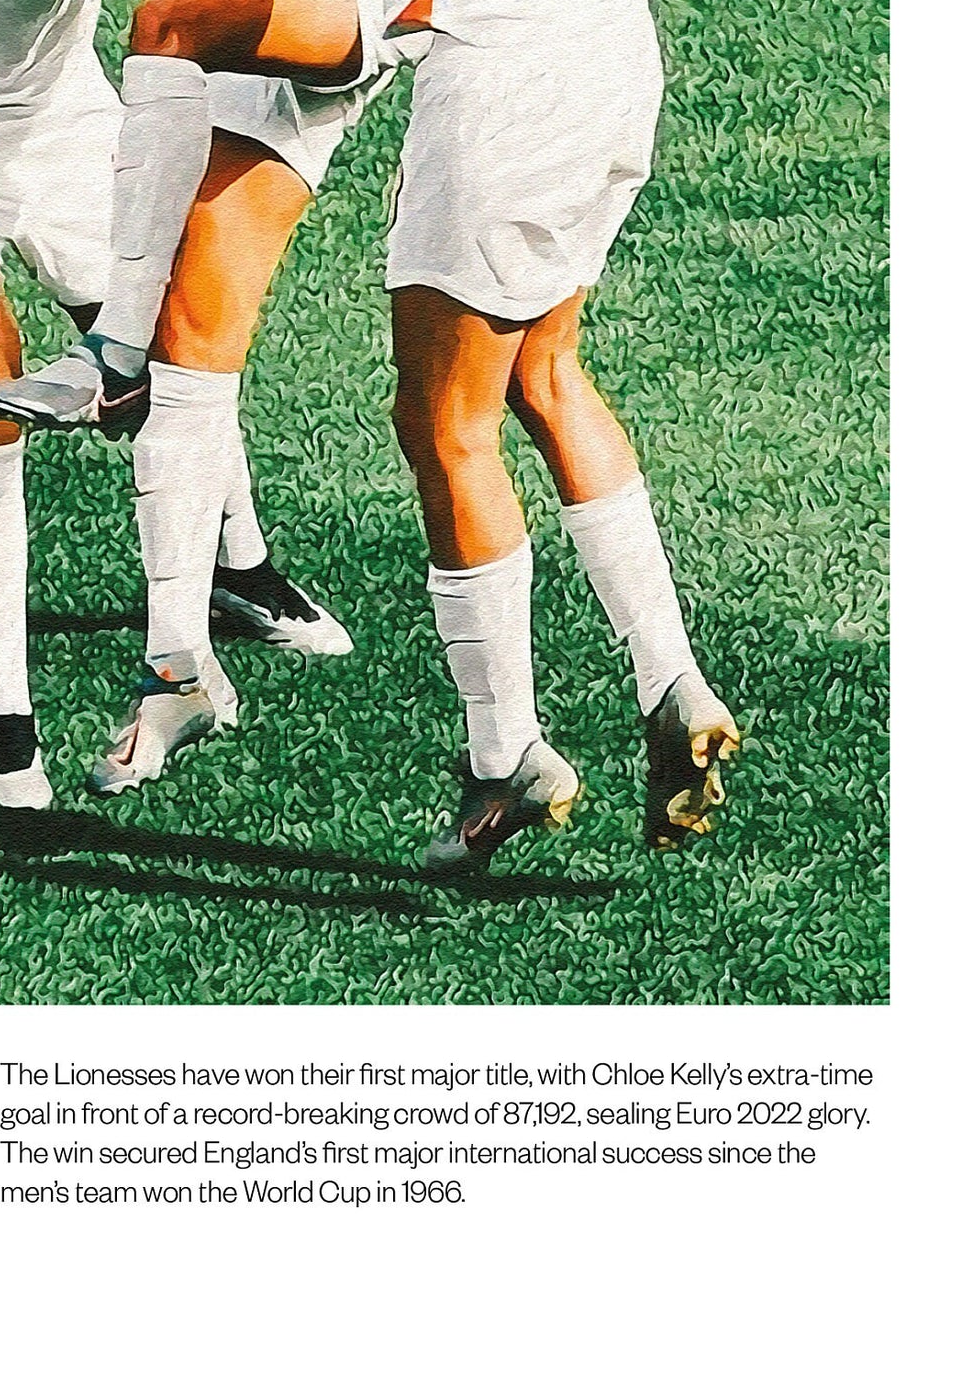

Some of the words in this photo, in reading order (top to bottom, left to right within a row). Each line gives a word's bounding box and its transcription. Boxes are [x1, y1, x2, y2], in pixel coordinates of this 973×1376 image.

[0, 1063, 48, 1085] The
[55, 1063, 176, 1085] Lionesses
[183, 1063, 239, 1085] have
[245, 1069, 293, 1085] won
[301, 1063, 355, 1085] their
[359, 1063, 405, 1085] first
[412, 1063, 480, 1091] major
[486, 1063, 532, 1087] title,
[538, 1063, 585, 1085] with
[592, 1063, 664, 1085] Chloe
[671, 1063, 742, 1090] Kelly’s
[748, 1063, 873, 1085] extra-time
[0, 1102, 50, 1130] goal
[57, 1102, 75, 1124] in
[81, 1102, 138, 1125] front
[144, 1102, 170, 1125] of
[174, 1108, 188, 1124] a
[195, 1102, 389, 1130] record-breaking
[394, 1102, 468, 1124] crowd
[475, 1102, 500, 1124] of
[503, 1102, 581, 1127] 87,192,
[587, 1102, 671, 1130] sealing
[677, 1102, 731, 1124] Euro
[737, 1102, 802, 1124] 2022
[808, 1102, 870, 1130] glory.
[0, 1141, 48, 1163] The
[53, 1141, 92, 1163] win
[99, 1141, 196, 1164] secured
[205, 1141, 317, 1169] England’s
[322, 1141, 368, 1163] first
[375, 1141, 443, 1169] major
[450, 1141, 596, 1164] international
[602, 1147, 702, 1164] success
[708, 1141, 771, 1164] since
[778, 1141, 815, 1164] the
[2, 1180, 69, 1203] men’s
[76, 1183, 136, 1203] team
[143, 1187, 191, 1203] won
[199, 1180, 237, 1203] the
[243, 1180, 313, 1203] World
[319, 1180, 370, 1207] Cup
[377, 1180, 395, 1202] in
[402, 1180, 465, 1203] 1966.
